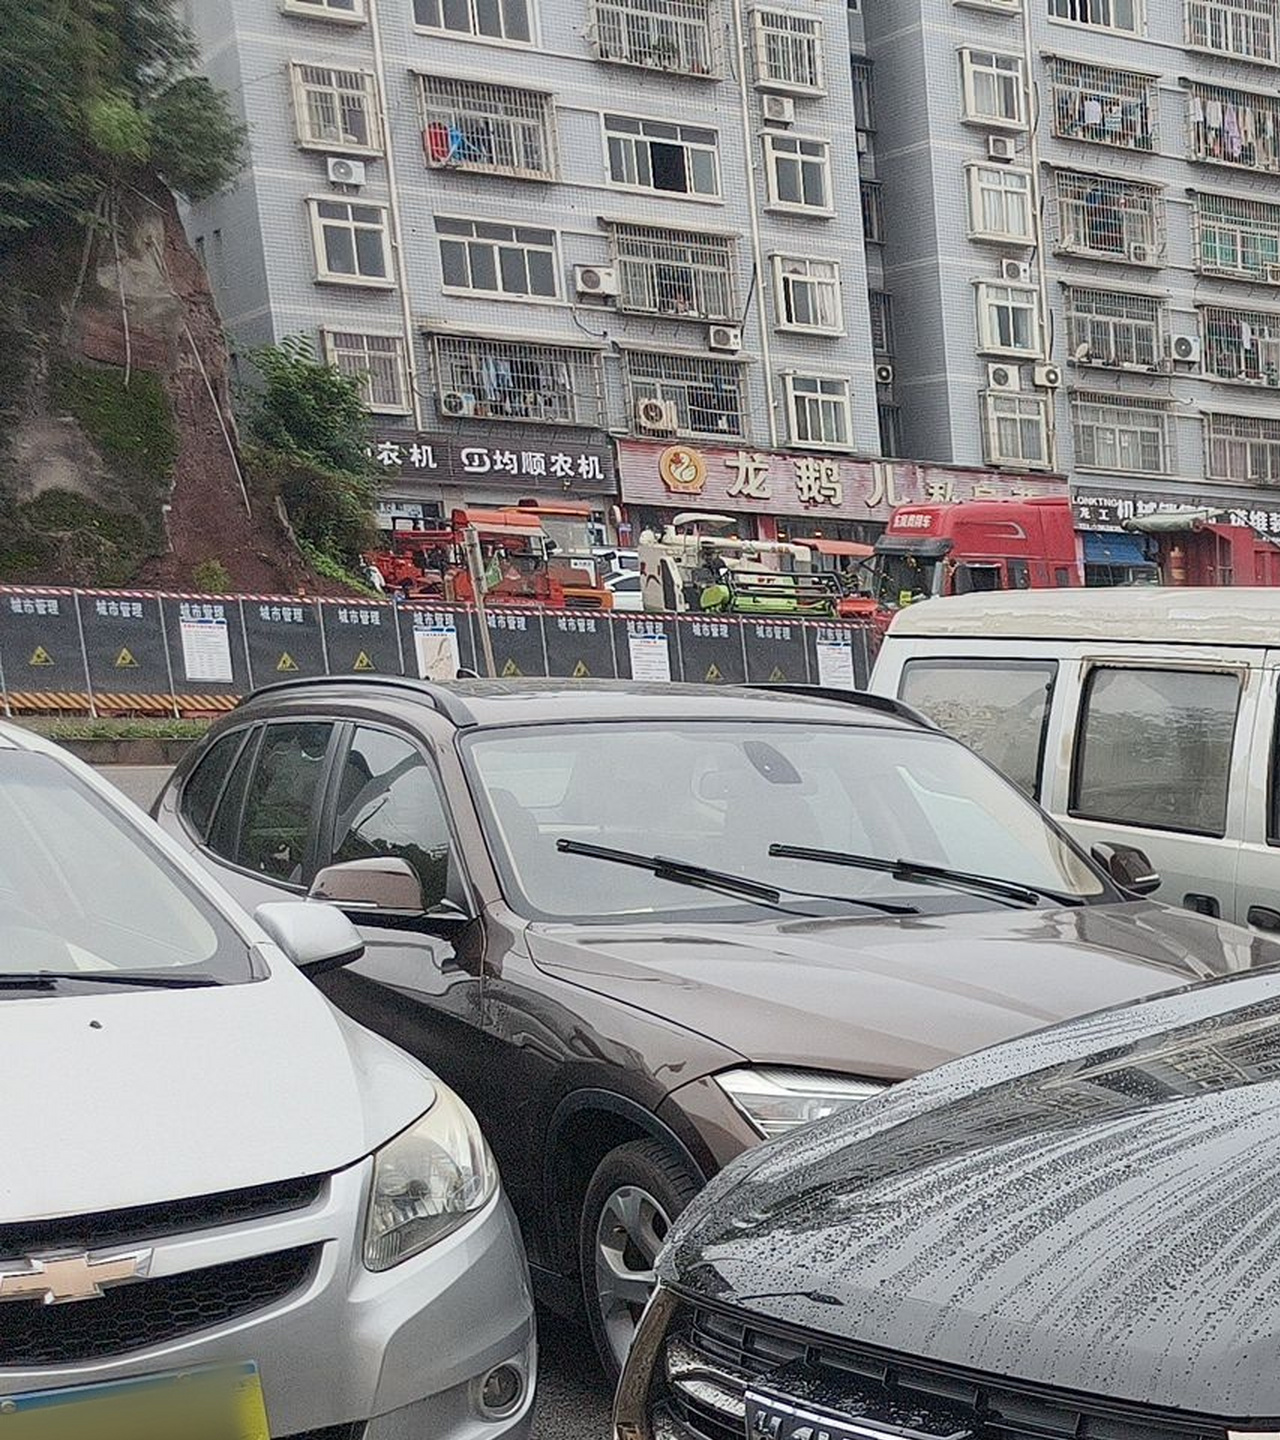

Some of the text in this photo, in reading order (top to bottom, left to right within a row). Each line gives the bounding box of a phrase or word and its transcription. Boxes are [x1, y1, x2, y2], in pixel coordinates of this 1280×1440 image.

[364, 441, 438, 469] 农机
[492, 448, 605, 480] 均顺农机
[10, 597, 59, 615] 城市管理
[96, 600, 143, 618] 城市管理
[180, 603, 224, 619] 城市管理
[259, 605, 304, 623] 城市管理
[338, 608, 381, 625] 城市管理
[413, 612, 454, 627] 城市管理
[487, 615, 527, 631] 城市管理
[557, 617, 596, 632] 城市管理
[626, 620, 664, 635] 城市管理
